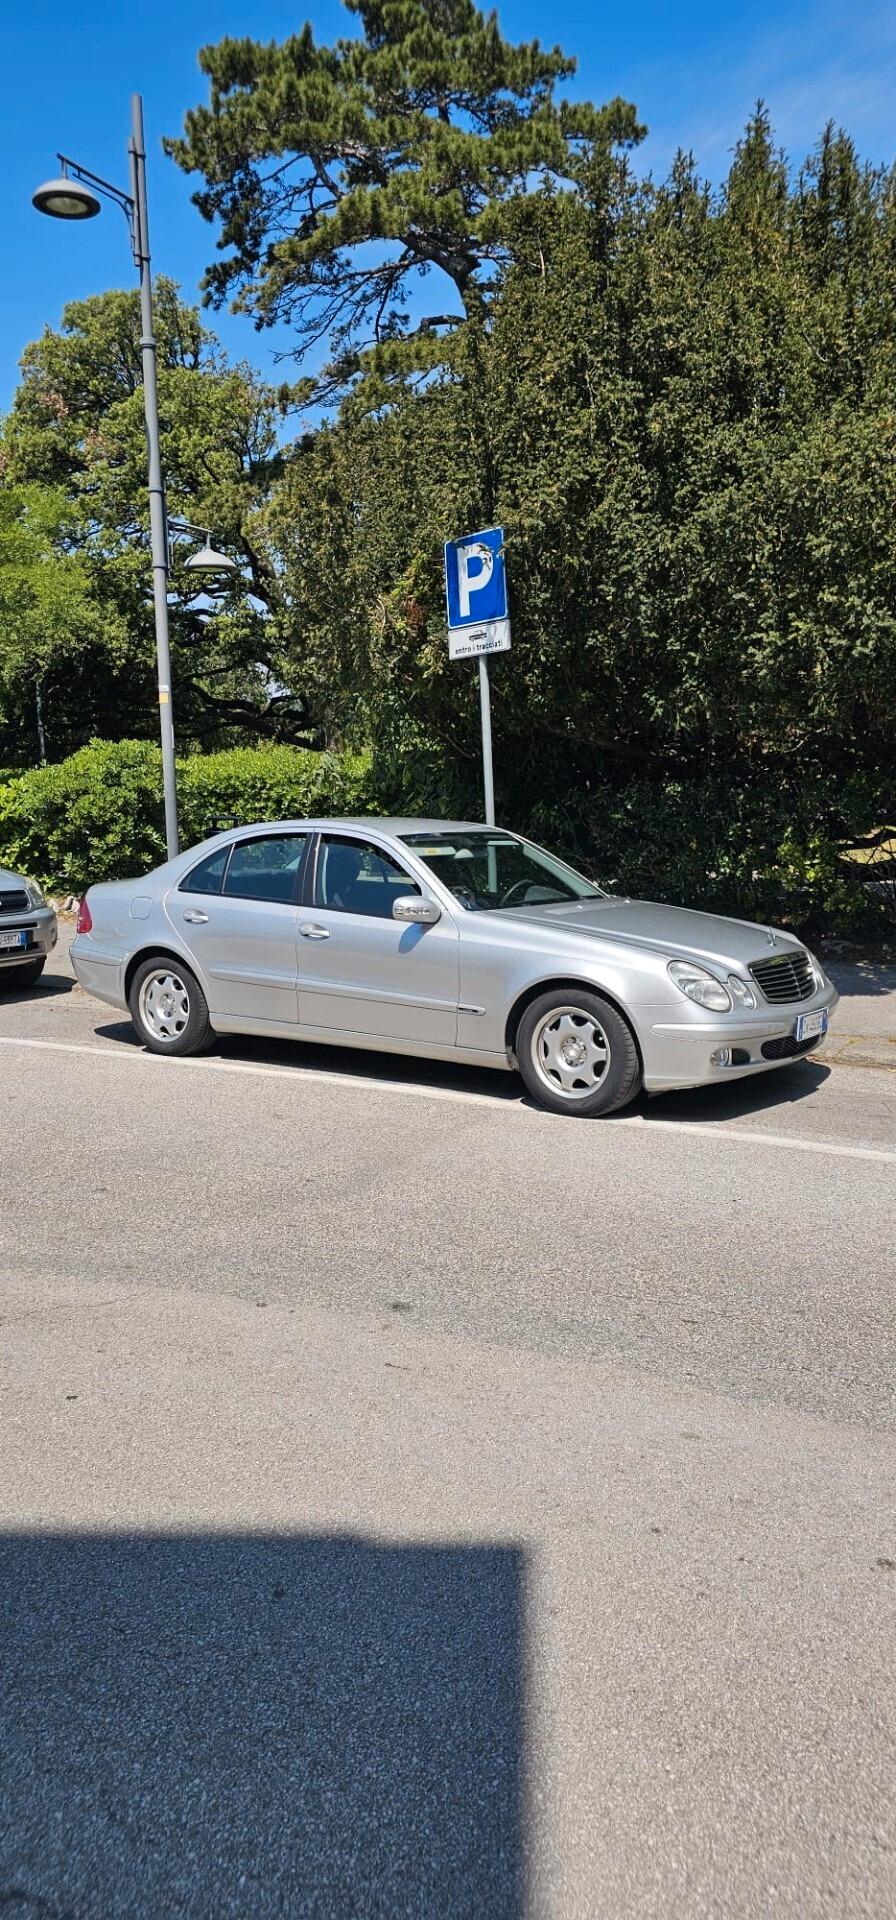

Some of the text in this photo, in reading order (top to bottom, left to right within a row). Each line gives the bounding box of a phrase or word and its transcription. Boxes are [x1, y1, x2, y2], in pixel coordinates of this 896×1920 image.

[457, 542, 493, 617] P
[455, 646, 471, 654] entro
[476, 639, 502, 651] tracciati
